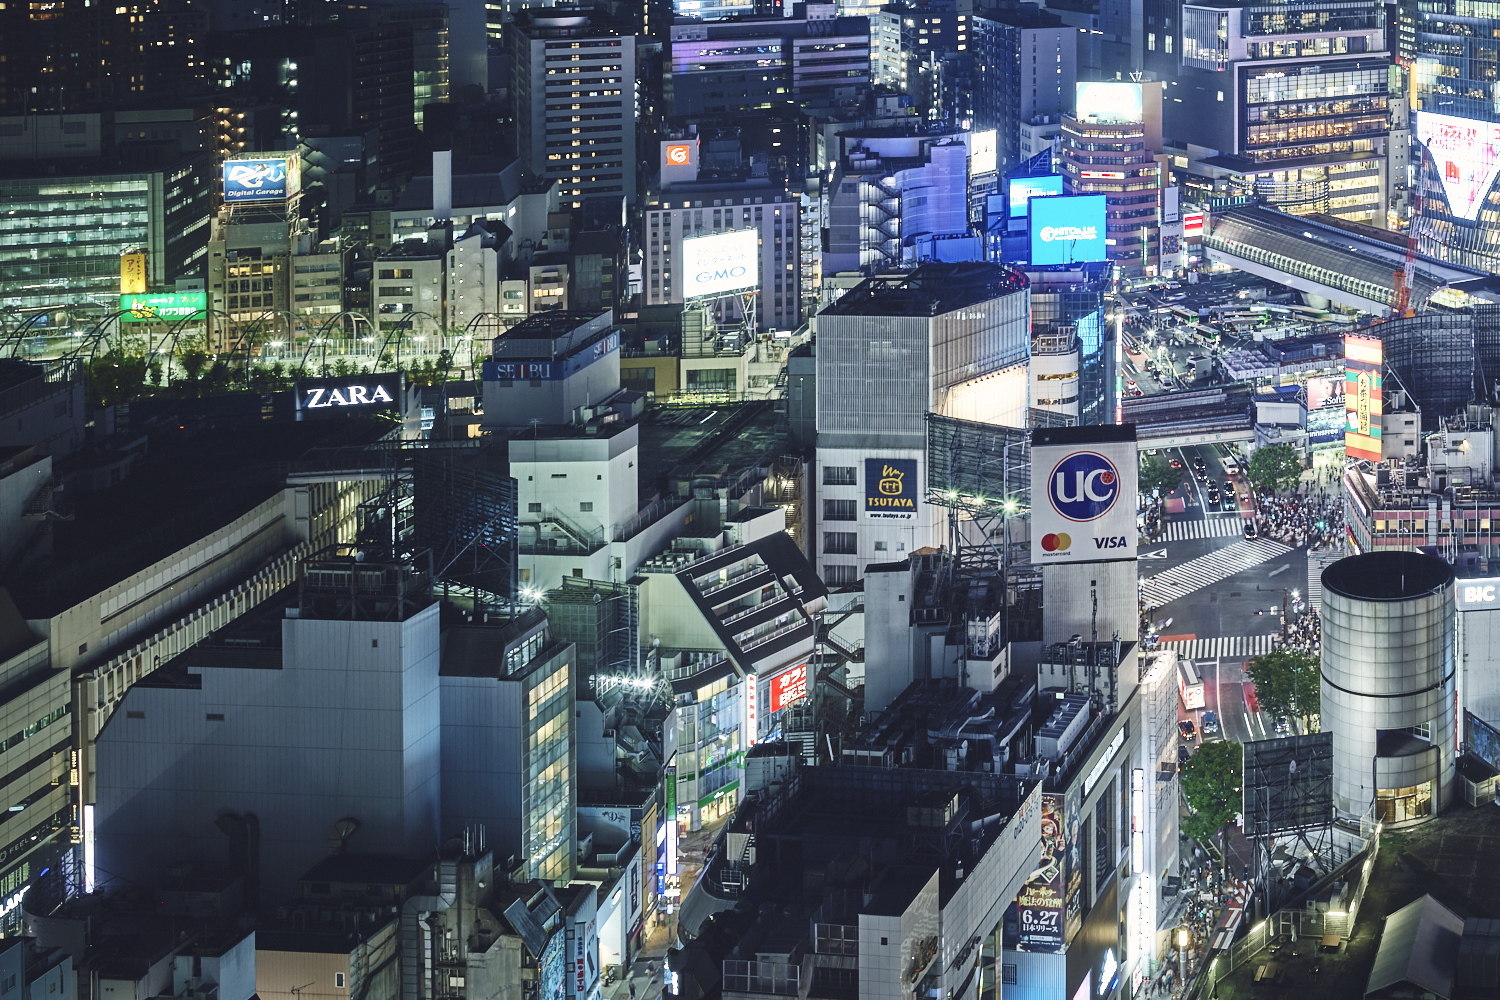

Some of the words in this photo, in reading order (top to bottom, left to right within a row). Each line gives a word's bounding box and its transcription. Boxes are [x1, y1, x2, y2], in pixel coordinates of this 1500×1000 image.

[695, 266, 746, 283] GMO
[497, 363, 551, 379] SEIBU
[306, 384, 393, 408] ZARA
[867, 497, 914, 507] TSUTAYA
[1092, 536, 1127, 549] VISA
[1464, 585, 1496, 603] BIC
[9, 838, 29, 854] FEEL
[1022, 909, 1059, 926] 6.27
[1022, 923, 1059, 933] 日本リリース
